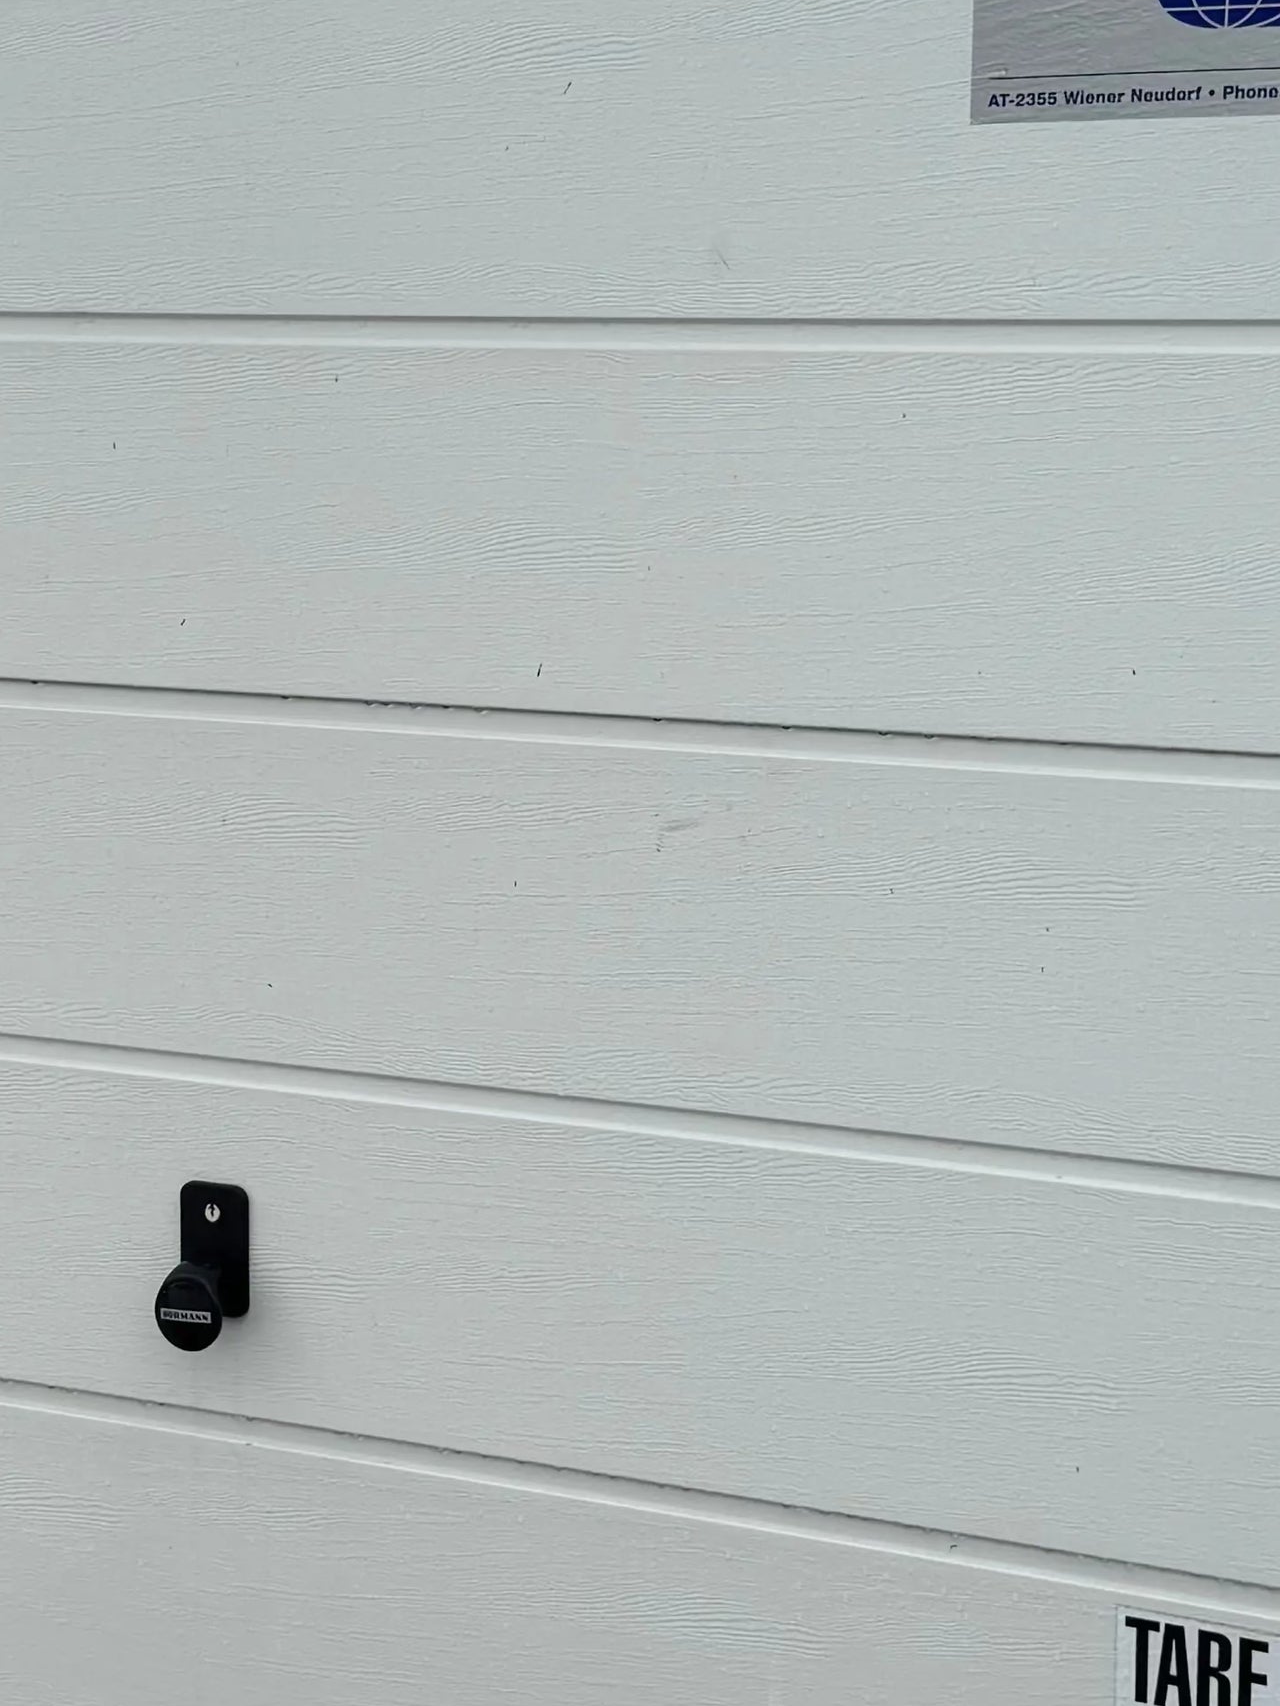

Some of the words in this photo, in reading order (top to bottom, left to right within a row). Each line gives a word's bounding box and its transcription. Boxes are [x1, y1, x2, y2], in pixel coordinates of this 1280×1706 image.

[988, 91, 1058, 108] AT-2355
[1063, 90, 1125, 105] Wiener
[1131, 86, 1203, 103] Neudorf
